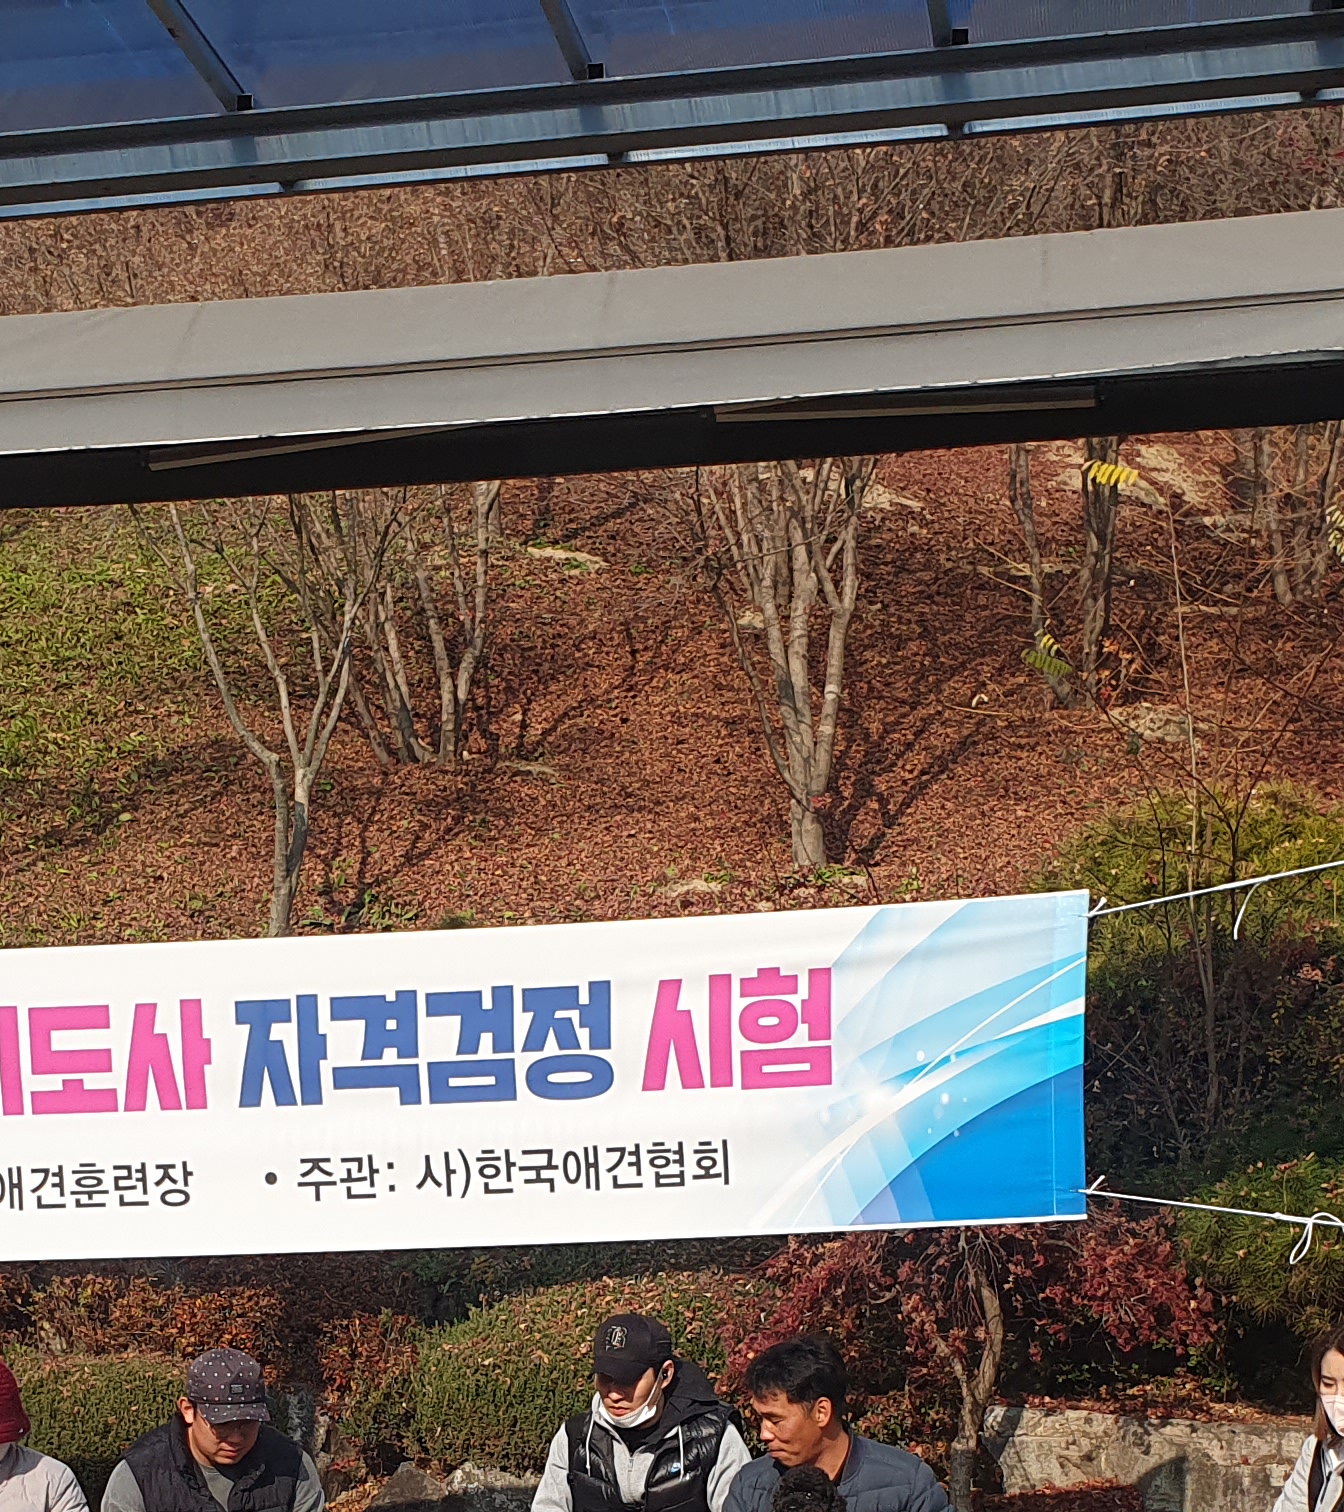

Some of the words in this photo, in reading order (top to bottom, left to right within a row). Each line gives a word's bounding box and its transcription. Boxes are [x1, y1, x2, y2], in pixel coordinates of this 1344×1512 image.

[234, 979, 615, 1108] 자격검정
[641, 966, 833, 1092] 시험
[297, 1154, 397, 1202] 주관:
[415, 1138, 731, 1199] 사)한국애견협회
